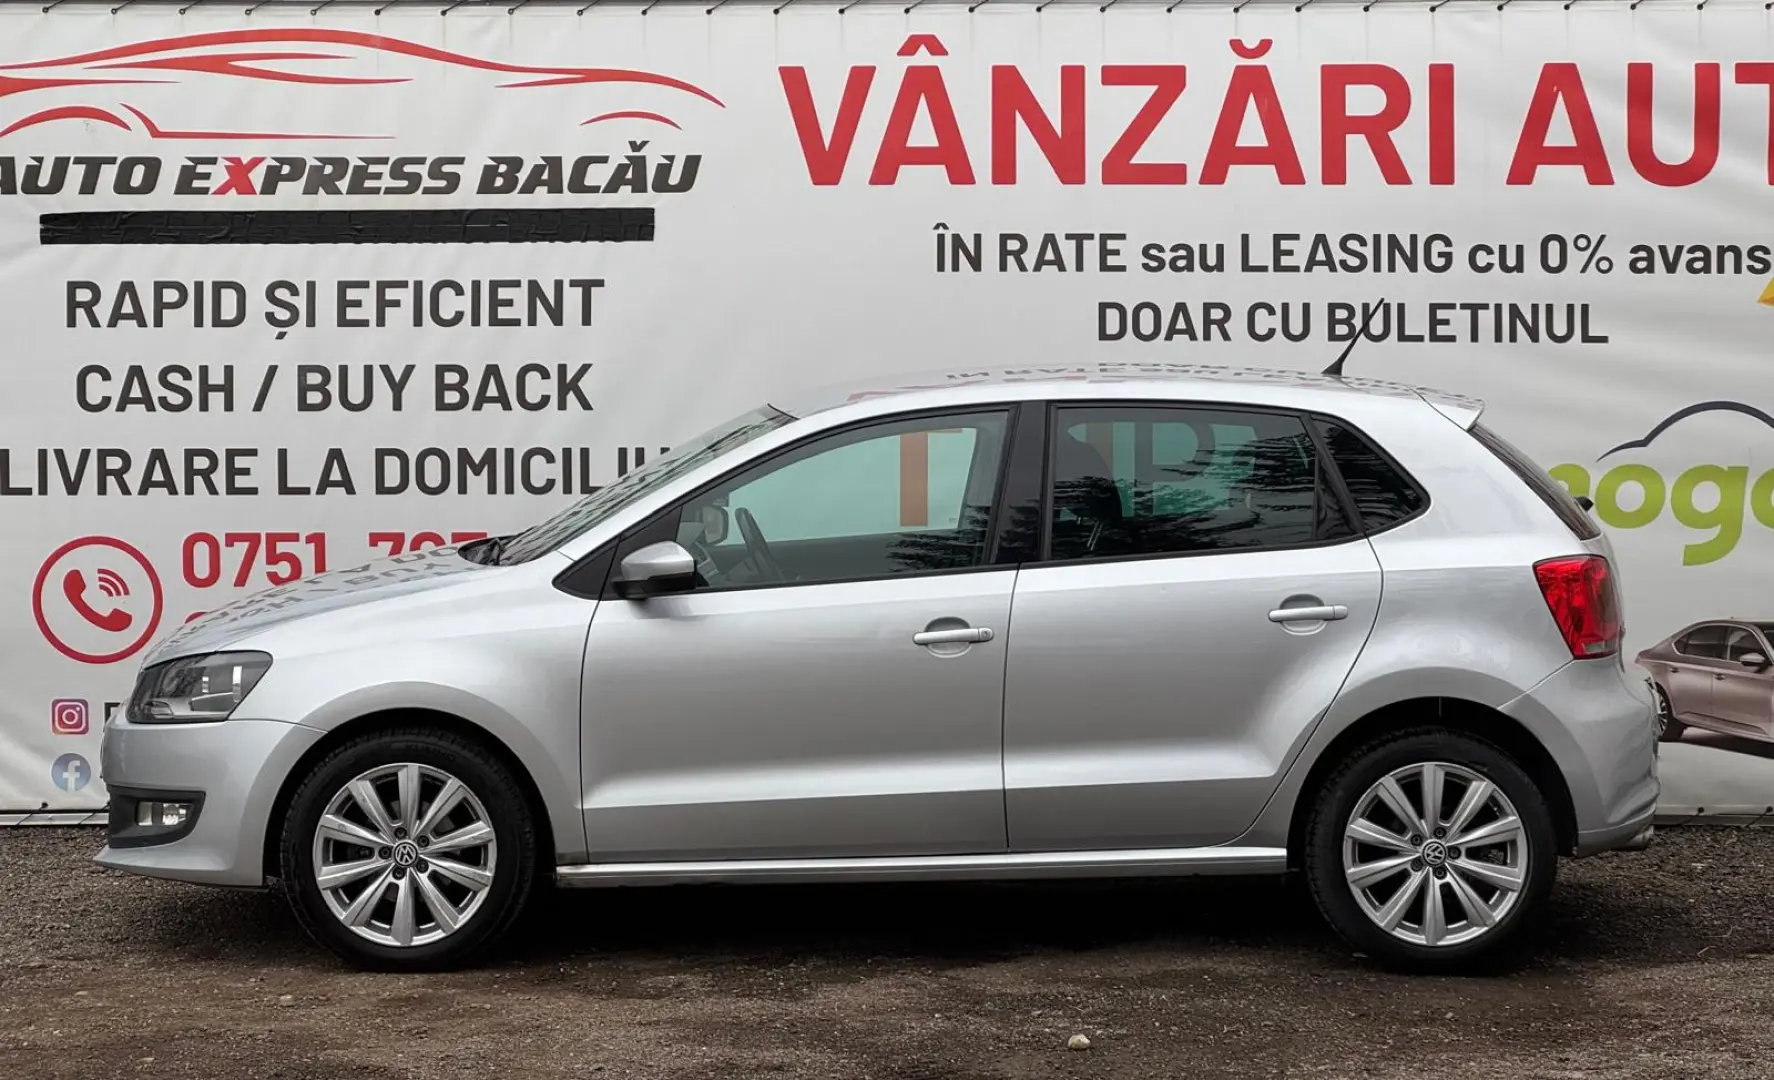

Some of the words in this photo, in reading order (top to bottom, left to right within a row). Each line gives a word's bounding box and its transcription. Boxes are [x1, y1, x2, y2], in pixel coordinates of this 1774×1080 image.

[779, 34, 1456, 186] VÂNZĂRI
[174, 156, 465, 195] EXPRESS
[477, 140, 702, 194] BACĂU
[934, 223, 981, 273] ÎN
[1000, 234, 1126, 273] RATE
[1142, 244, 1224, 274] sau
[1242, 234, 1452, 273] LEASING
[1469, 244, 1523, 274] cu
[1541, 234, 1613, 274] 0%
[1629, 244, 1772, 275] avans
[66, 281, 246, 328] RAPID
[337, 279, 605, 327] EFICIENT
[1099, 302, 1231, 342] DOAR
[1247, 302, 1311, 342] CU
[1327, 302, 1609, 344] BULETINUL
[76, 364, 234, 412] CASH
[253, 364, 278, 411] /
[298, 364, 415, 412] BUY
[436, 363, 594, 412] BACK
[1, 448, 258, 496] LIVRARE
[278, 447, 356, 495] LA
[375, 446, 671, 496] DOMICILI
[182, 532, 326, 589] 0751
